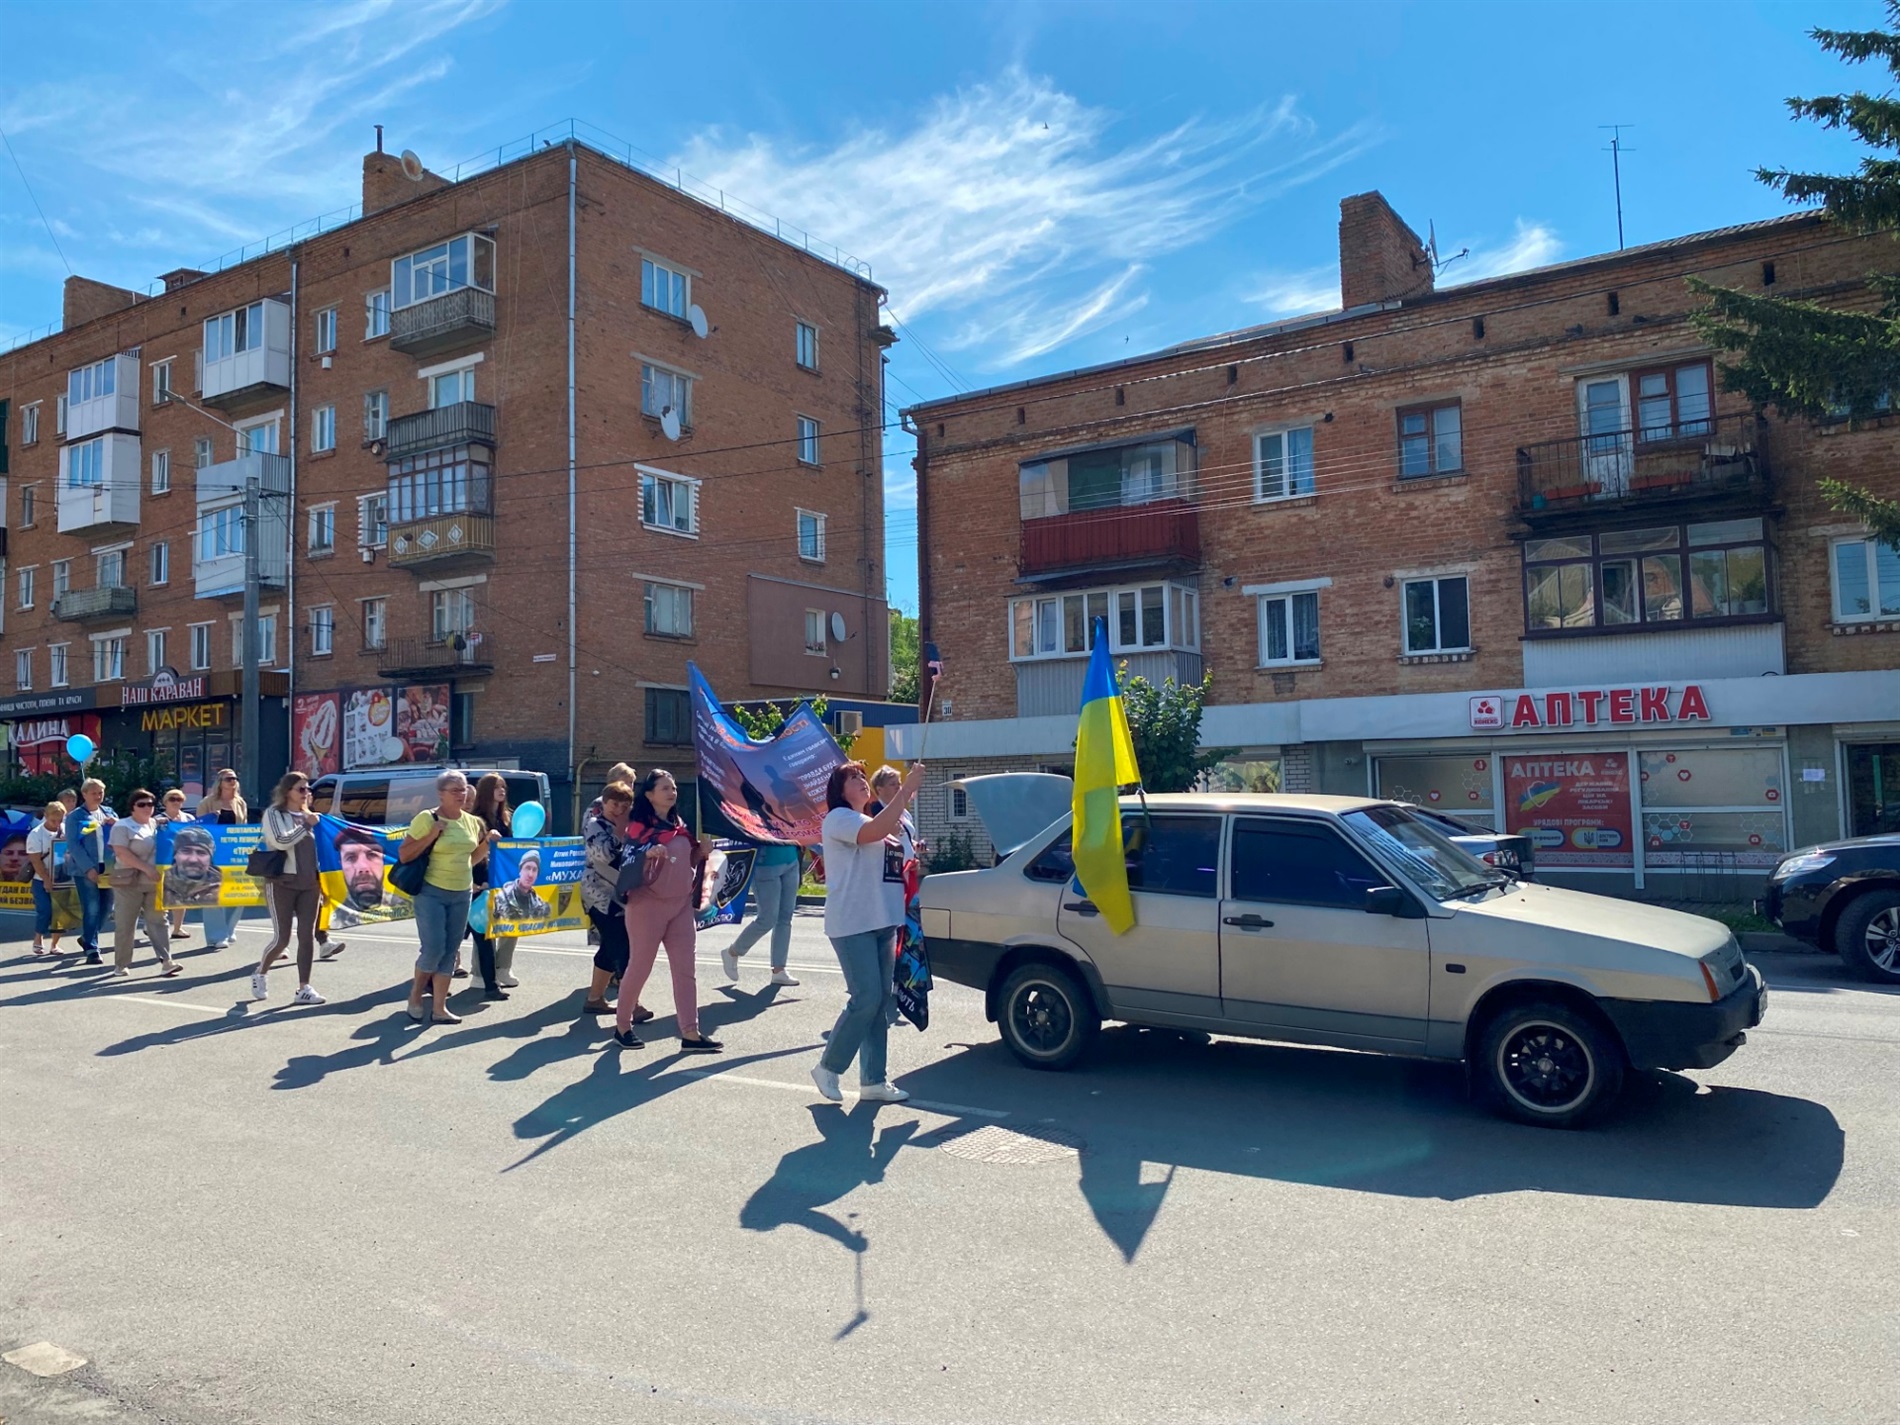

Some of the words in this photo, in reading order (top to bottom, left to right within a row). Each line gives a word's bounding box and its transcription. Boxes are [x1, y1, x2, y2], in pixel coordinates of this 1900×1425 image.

[122, 687, 148, 704] НАШ
[150, 677, 202, 702] КАРАВАН
[141, 703, 224, 732] МАРКЕТ
[943, 706, 952, 715] 30
[1511, 685, 1711, 728] АПТЕКА
[8, 719, 70, 743] КАЛИНА
[1511, 760, 1595, 778] АПТЕКА
